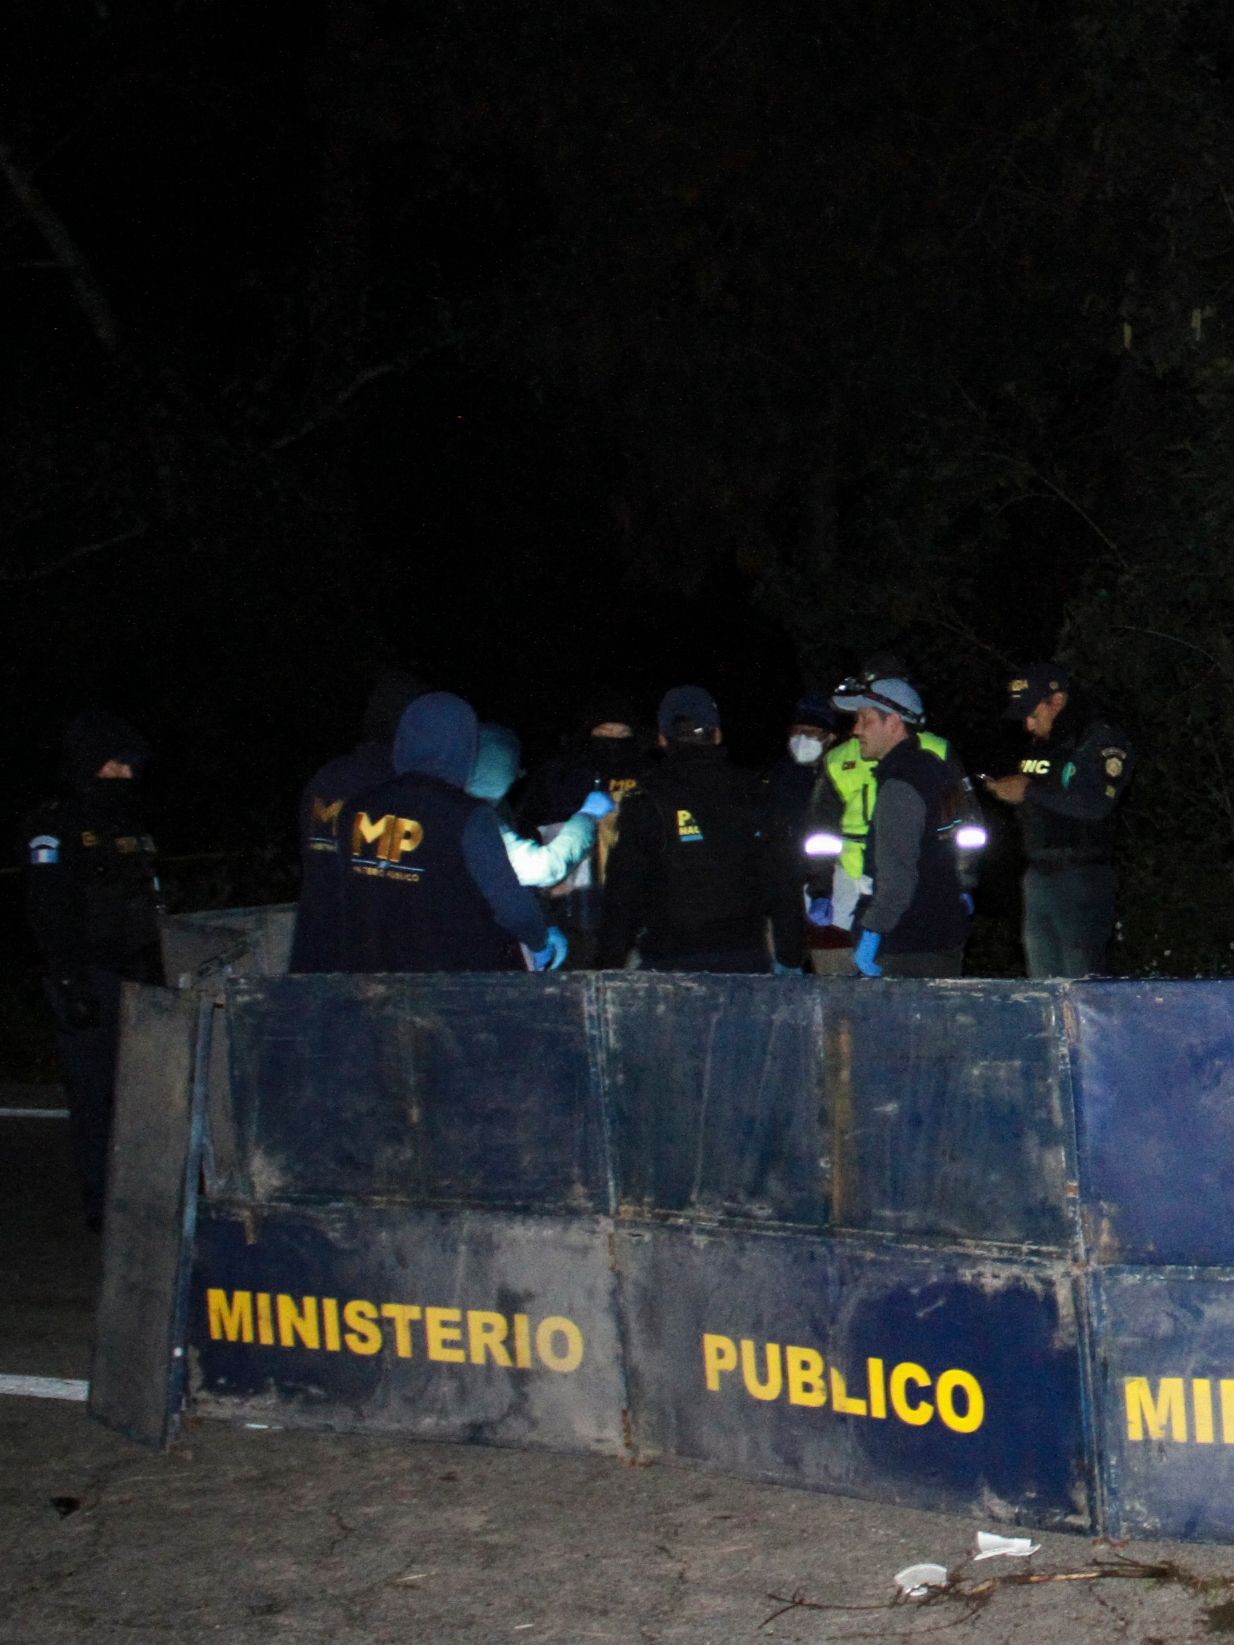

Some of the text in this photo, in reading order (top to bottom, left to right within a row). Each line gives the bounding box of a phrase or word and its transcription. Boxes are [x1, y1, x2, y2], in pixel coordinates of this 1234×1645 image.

[352, 811, 425, 863] MP
[206, 1288, 986, 1435] MINISTERIO PUBLICO
